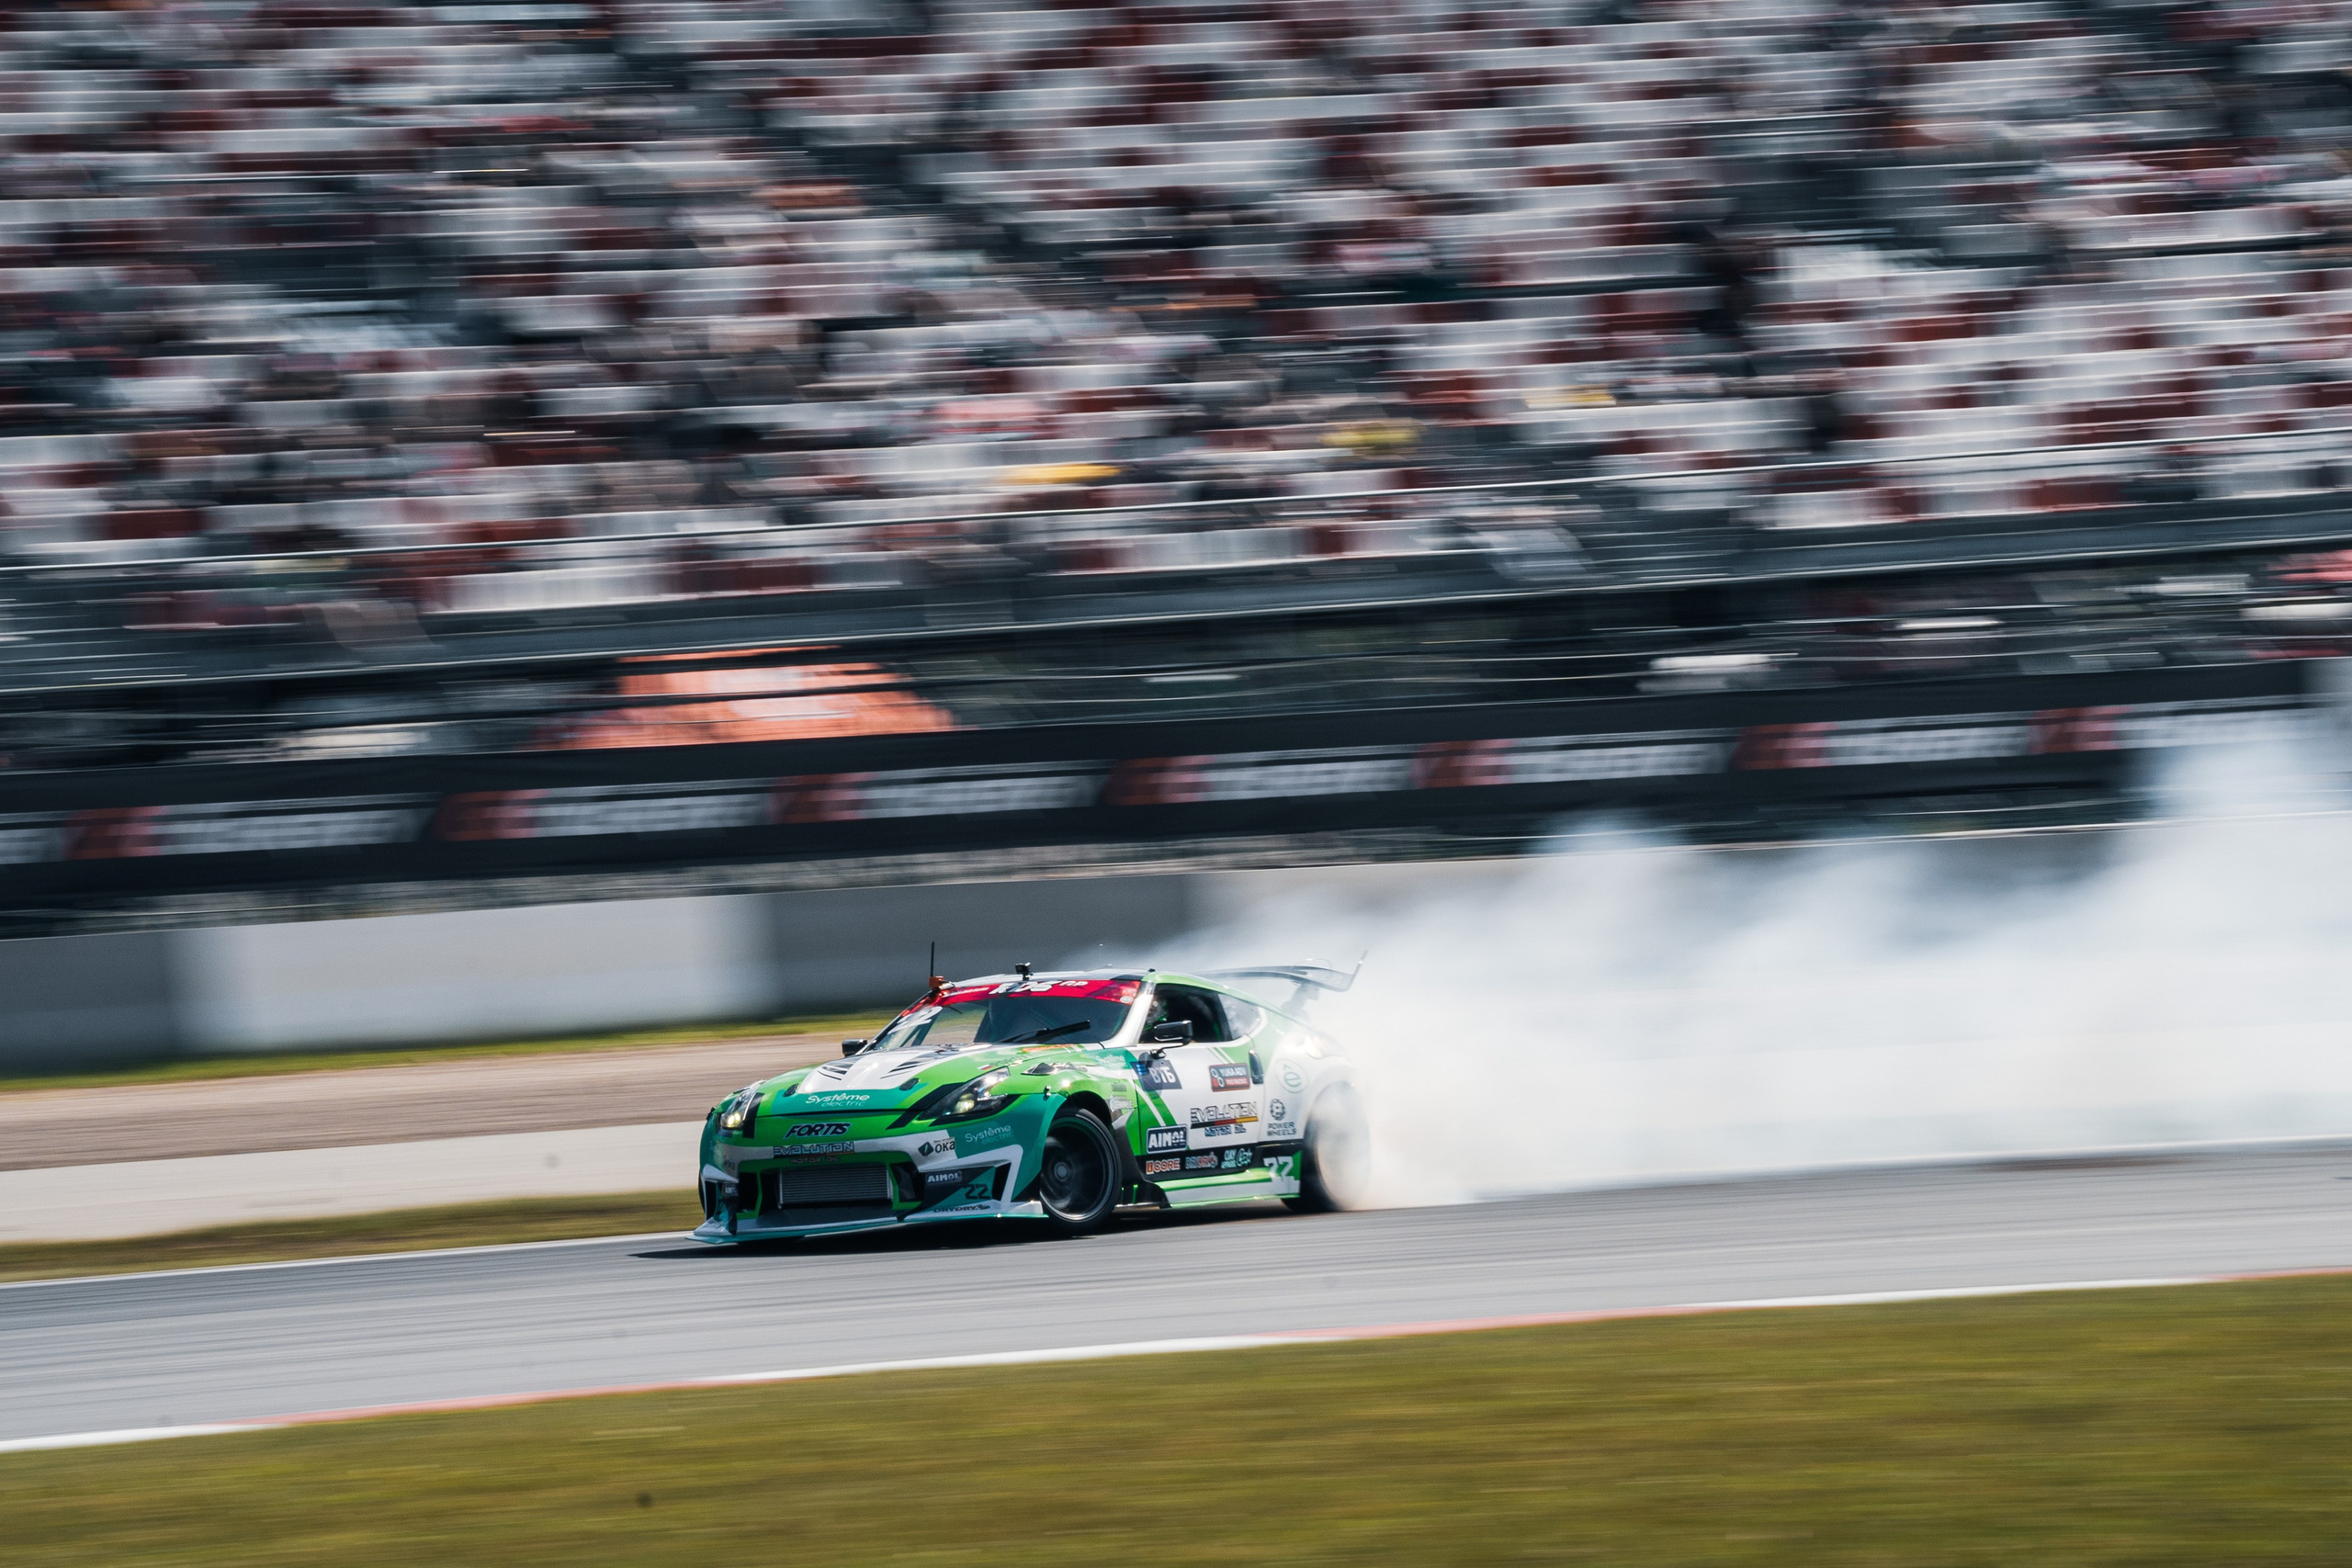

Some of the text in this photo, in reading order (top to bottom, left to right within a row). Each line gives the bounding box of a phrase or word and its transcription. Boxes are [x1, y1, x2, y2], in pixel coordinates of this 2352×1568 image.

[990, 981, 1062, 995] RDS
[806, 1093, 870, 1104] Système
[783, 1122, 852, 1139] FORTIS
[965, 1125, 1012, 1143] Système
[1148, 1131, 1185, 1148] AIMOL
[774, 1142, 854, 1156] EVOLUTION
[927, 1172, 960, 1183] AIMOL
[962, 1183, 991, 1200] 22
